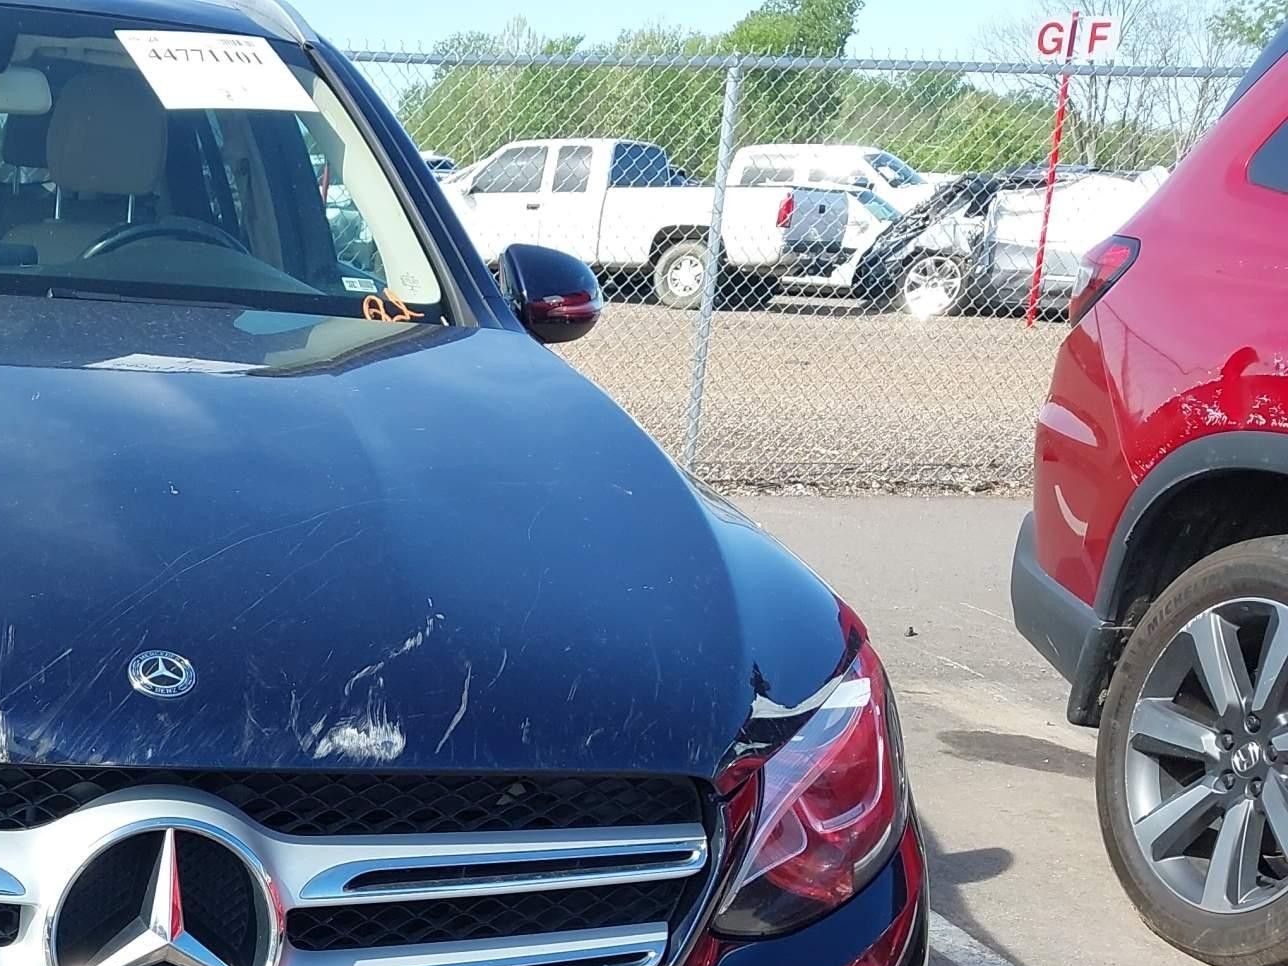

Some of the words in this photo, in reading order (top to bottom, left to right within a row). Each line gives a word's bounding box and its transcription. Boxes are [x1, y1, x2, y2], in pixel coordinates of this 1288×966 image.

[1038, 22, 1064, 55] G
[1088, 22, 1111, 54] F
[148, 48, 263, 65] 44771101
